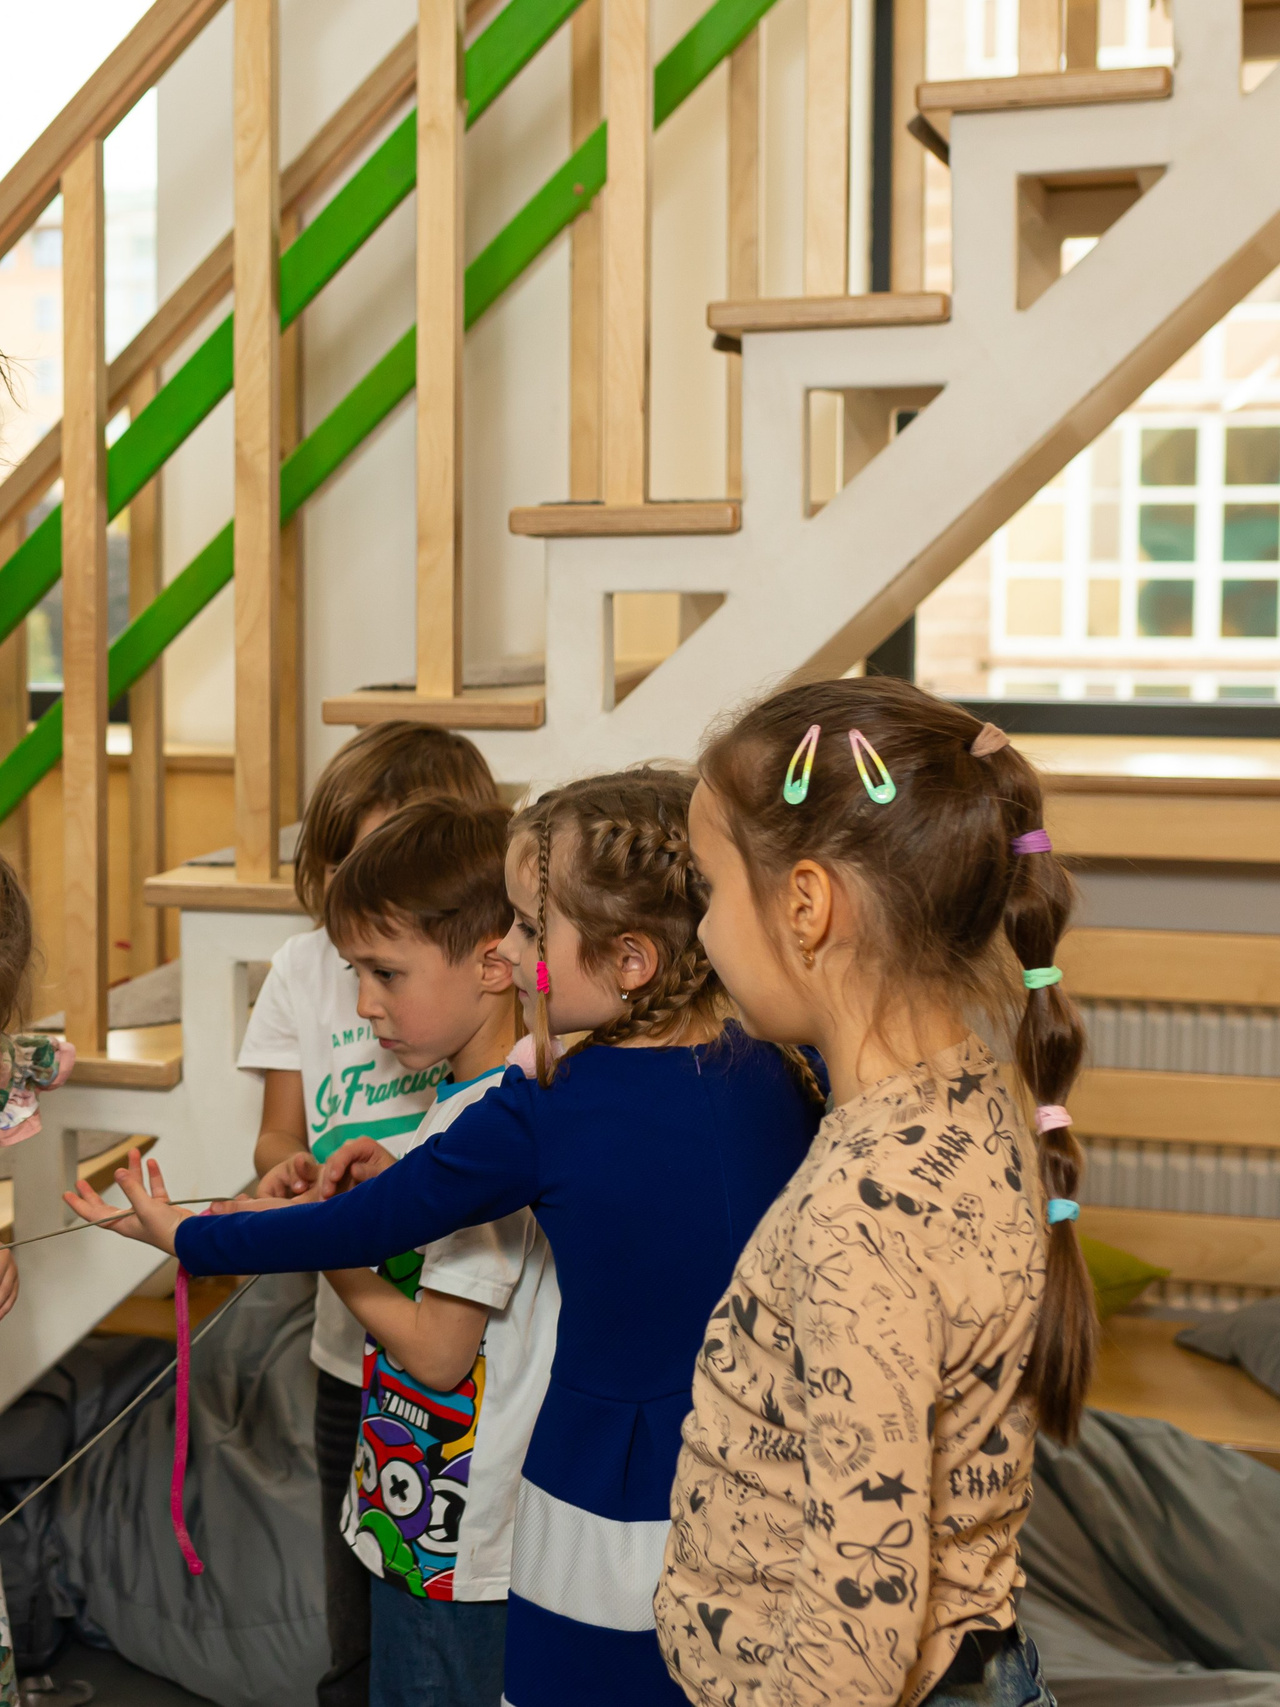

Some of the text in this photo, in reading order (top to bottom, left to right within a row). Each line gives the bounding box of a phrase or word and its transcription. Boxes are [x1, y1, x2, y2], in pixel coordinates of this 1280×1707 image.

[331, 1024, 379, 1048] AMPI
[907, 1124, 981, 1194] CHAOS
[877, 1412, 905, 1443] ME
